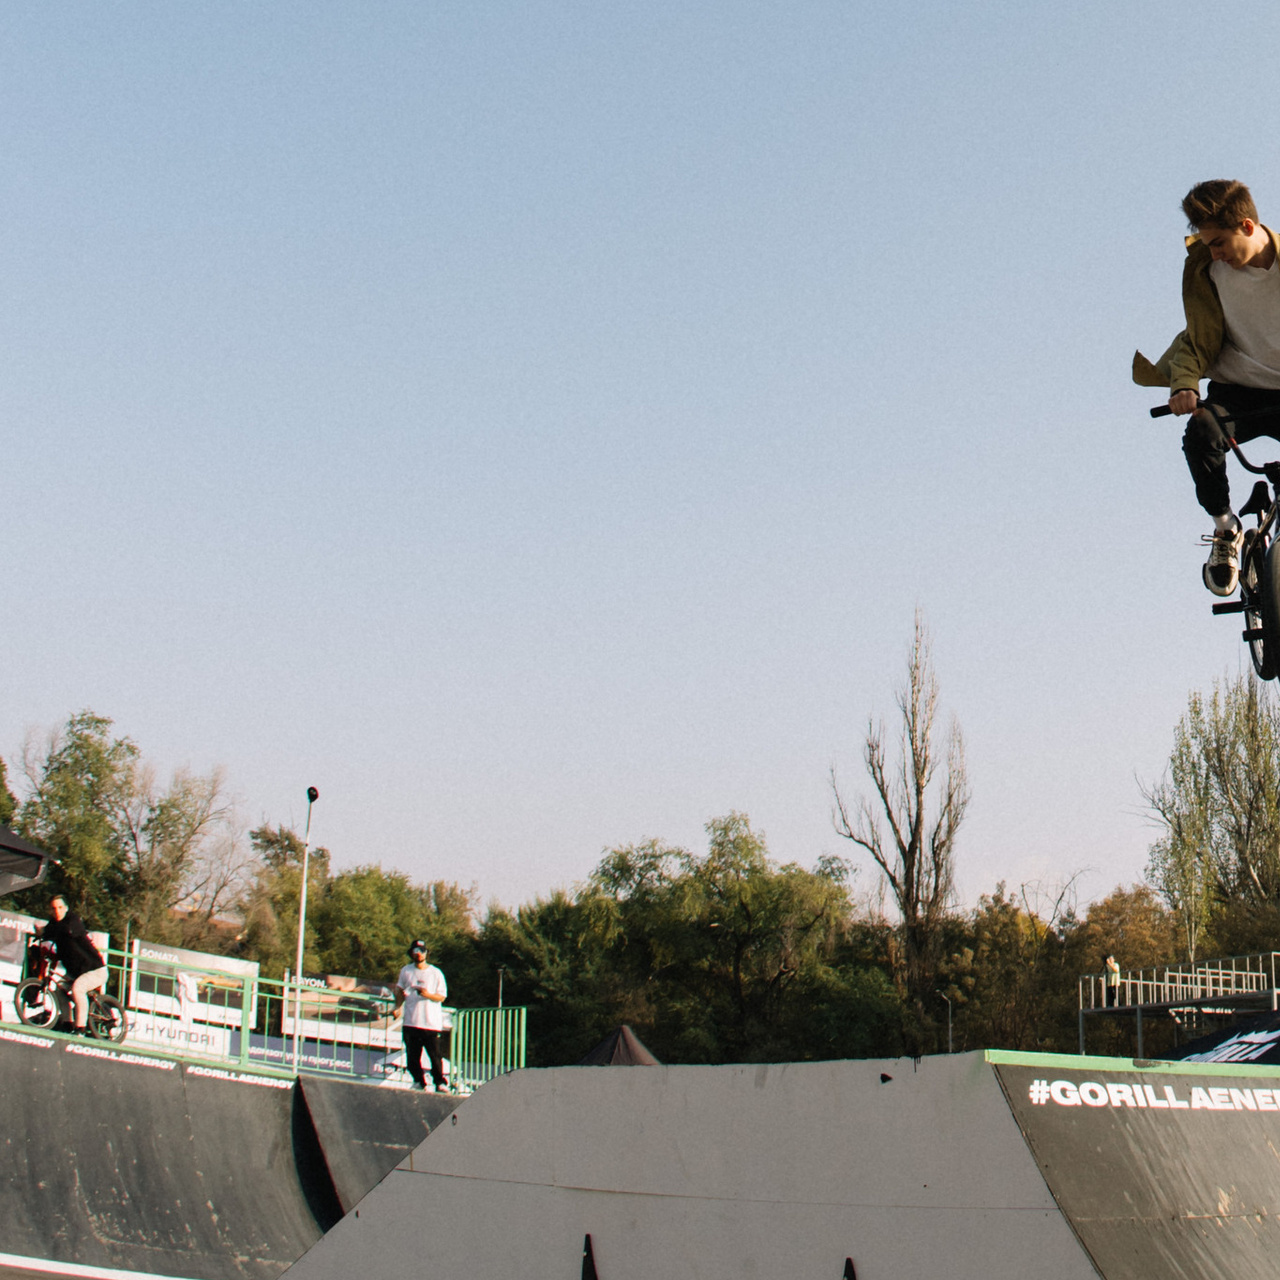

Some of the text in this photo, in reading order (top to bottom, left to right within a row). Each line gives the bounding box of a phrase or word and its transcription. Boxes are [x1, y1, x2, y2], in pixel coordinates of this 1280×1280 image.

[145, 1023, 215, 1046] HYUNDAI
[65, 1043, 177, 1070] #GORILLAENERGY
[186, 1066, 295, 1089] #GORILLAENERGY
